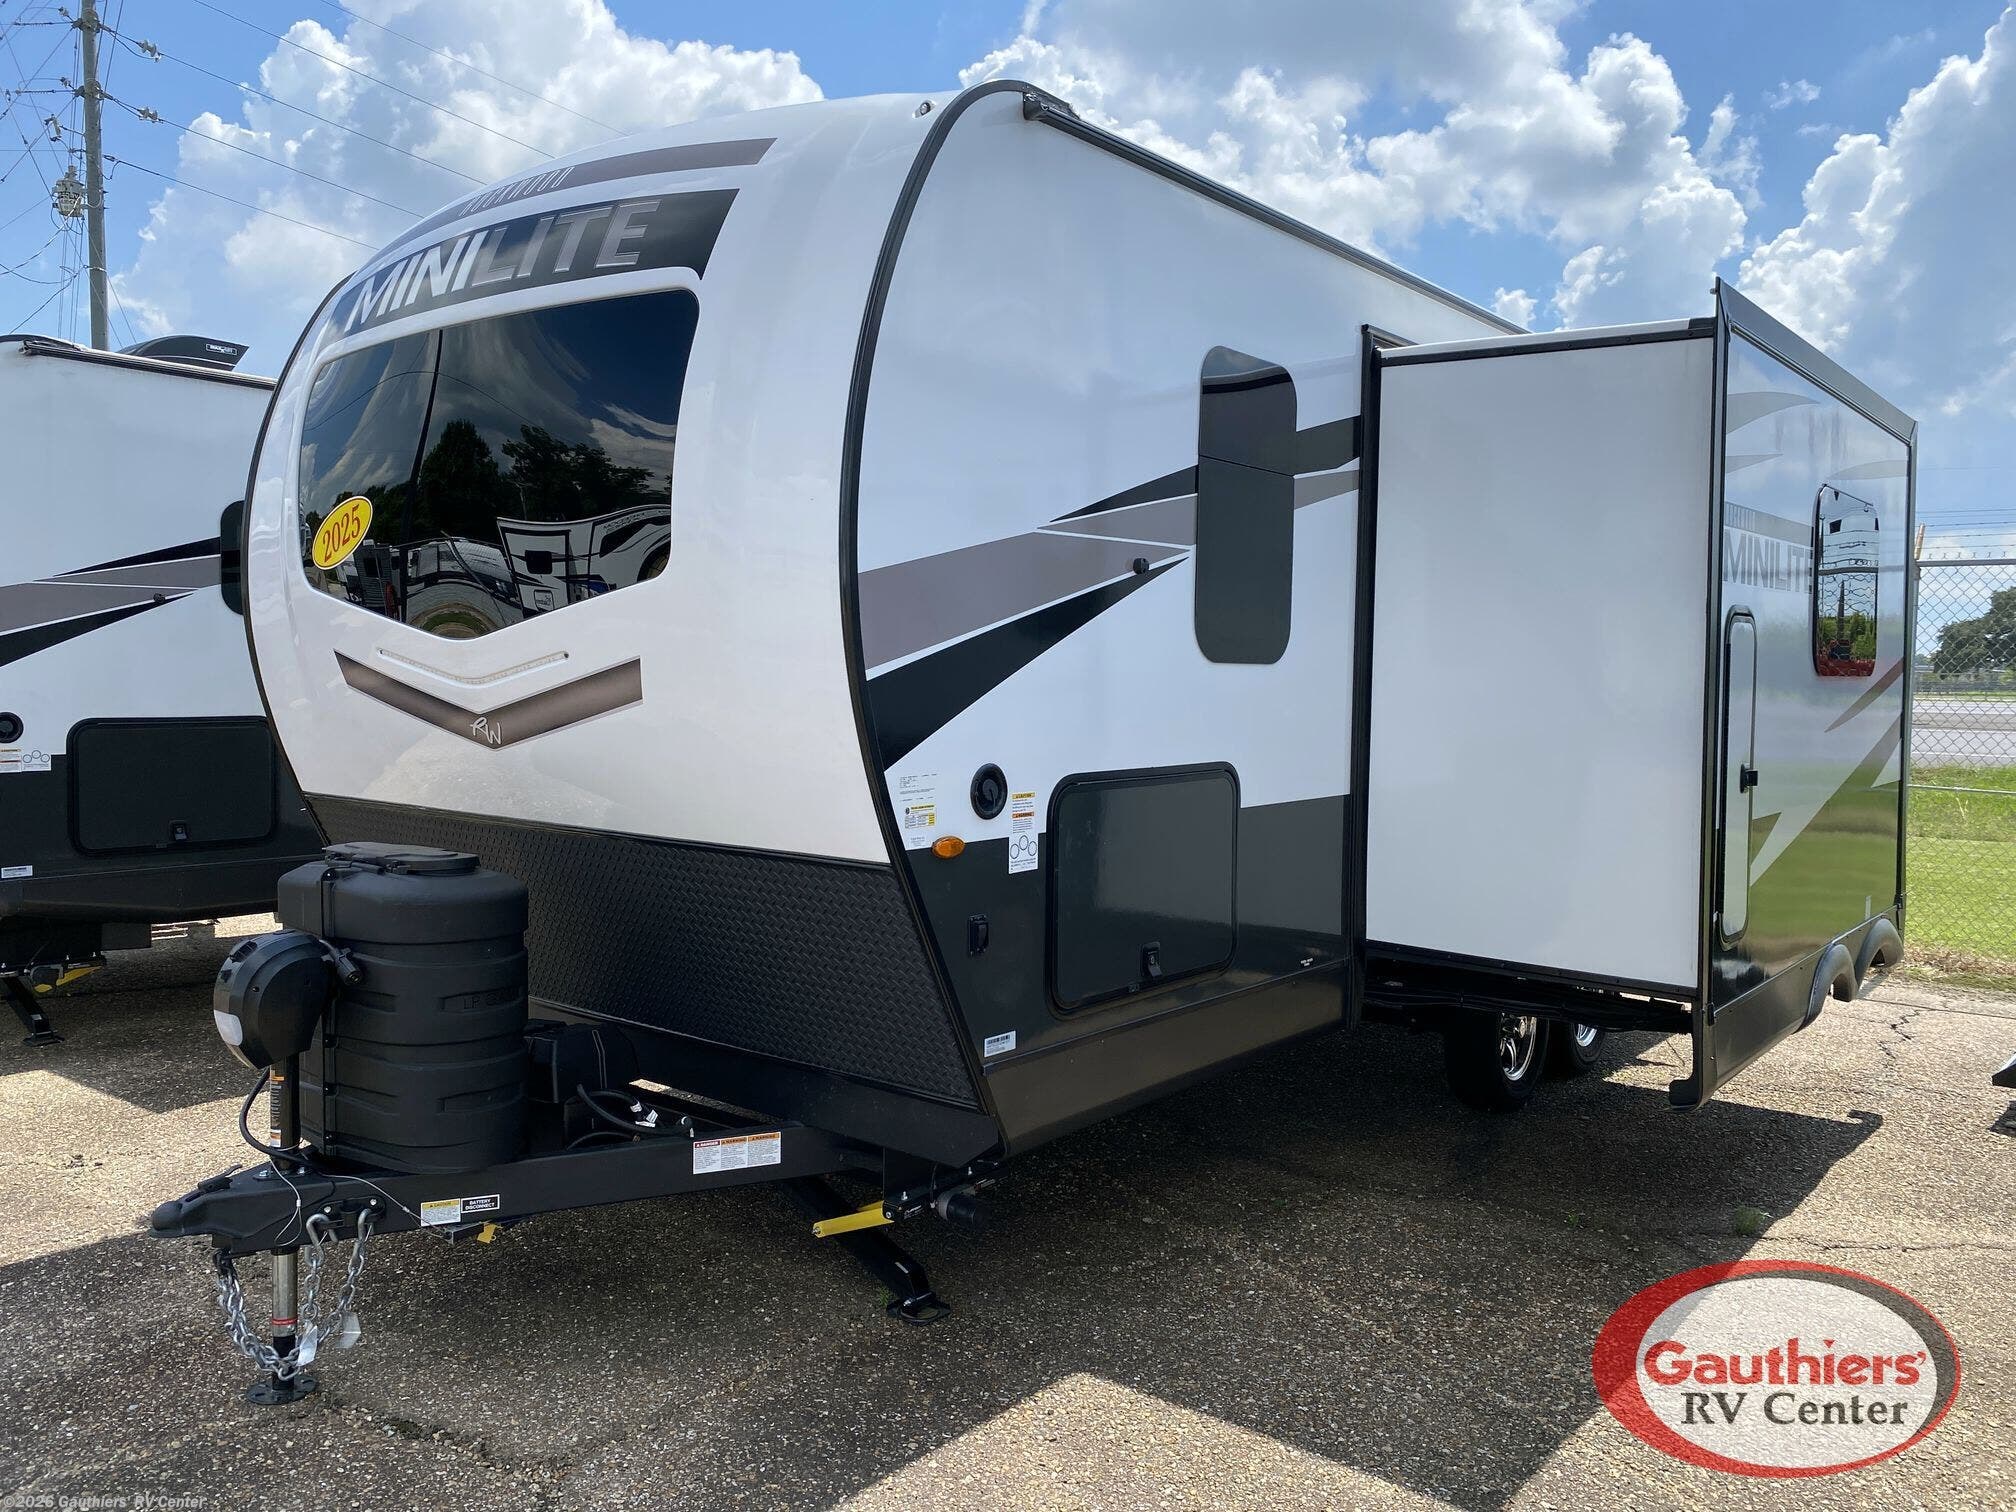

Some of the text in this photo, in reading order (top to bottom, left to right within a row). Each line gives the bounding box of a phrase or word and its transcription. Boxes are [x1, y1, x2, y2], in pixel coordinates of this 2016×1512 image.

[344, 199, 662, 334] MINILITE
[322, 503, 361, 563] 2025
[469, 716, 503, 745] RW
[464, 1202, 495, 1211] DISCONNECT
[469, 1198, 491, 1206] BATTERY
